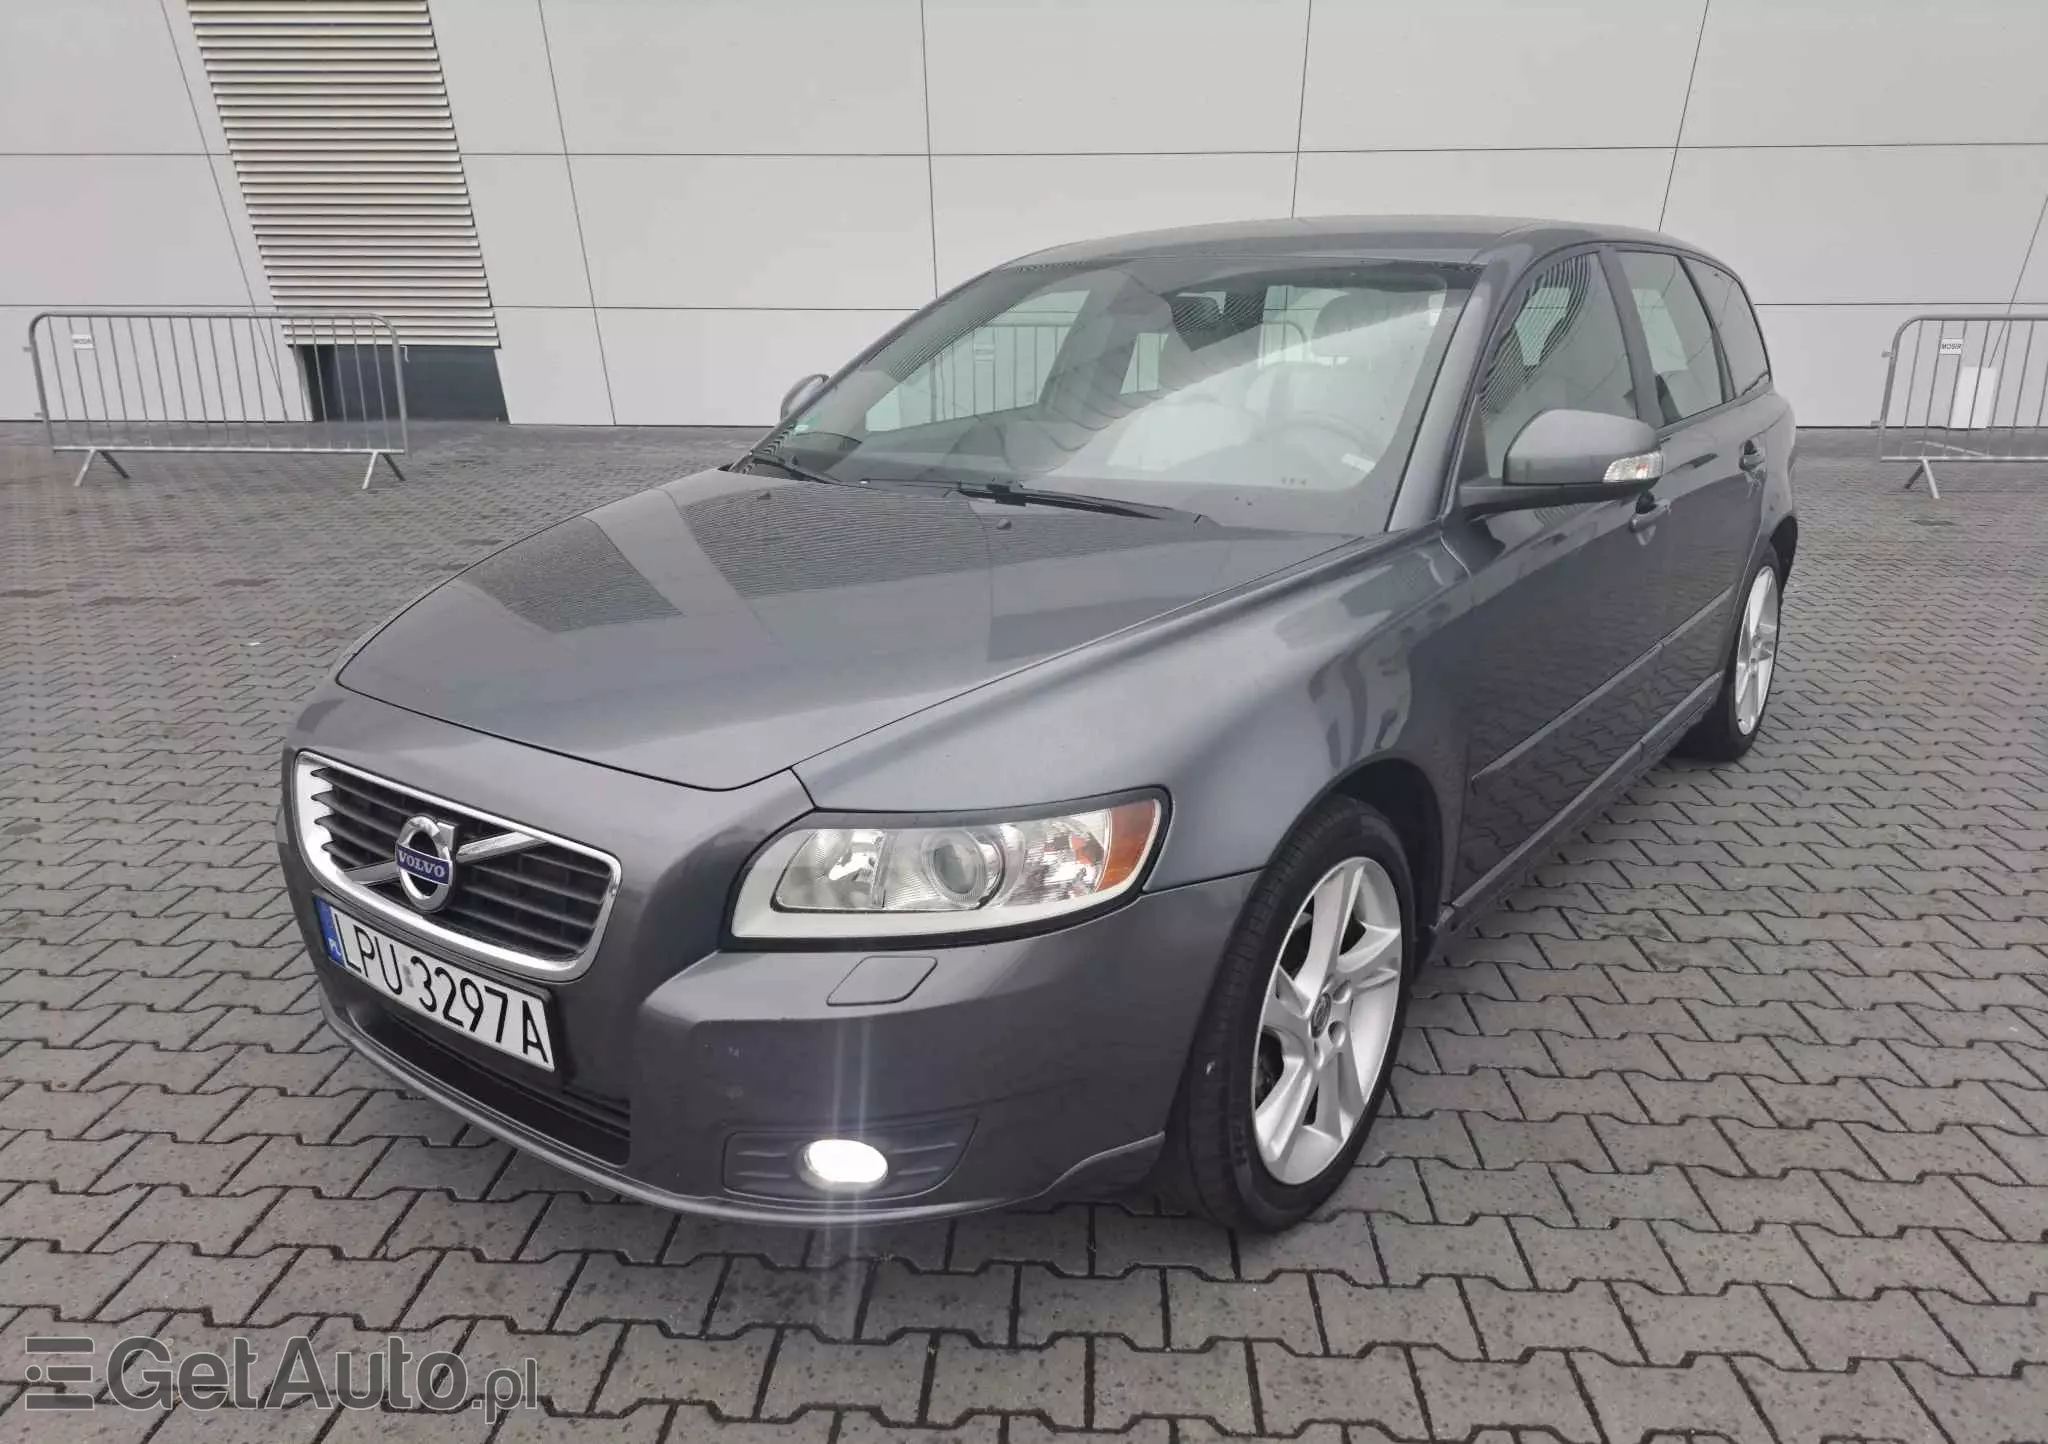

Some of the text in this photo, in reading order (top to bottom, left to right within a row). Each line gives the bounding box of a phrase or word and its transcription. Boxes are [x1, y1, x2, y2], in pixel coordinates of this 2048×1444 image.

[398, 850, 446, 878] VOLVO
[334, 912, 549, 1064] LPU 3297A
